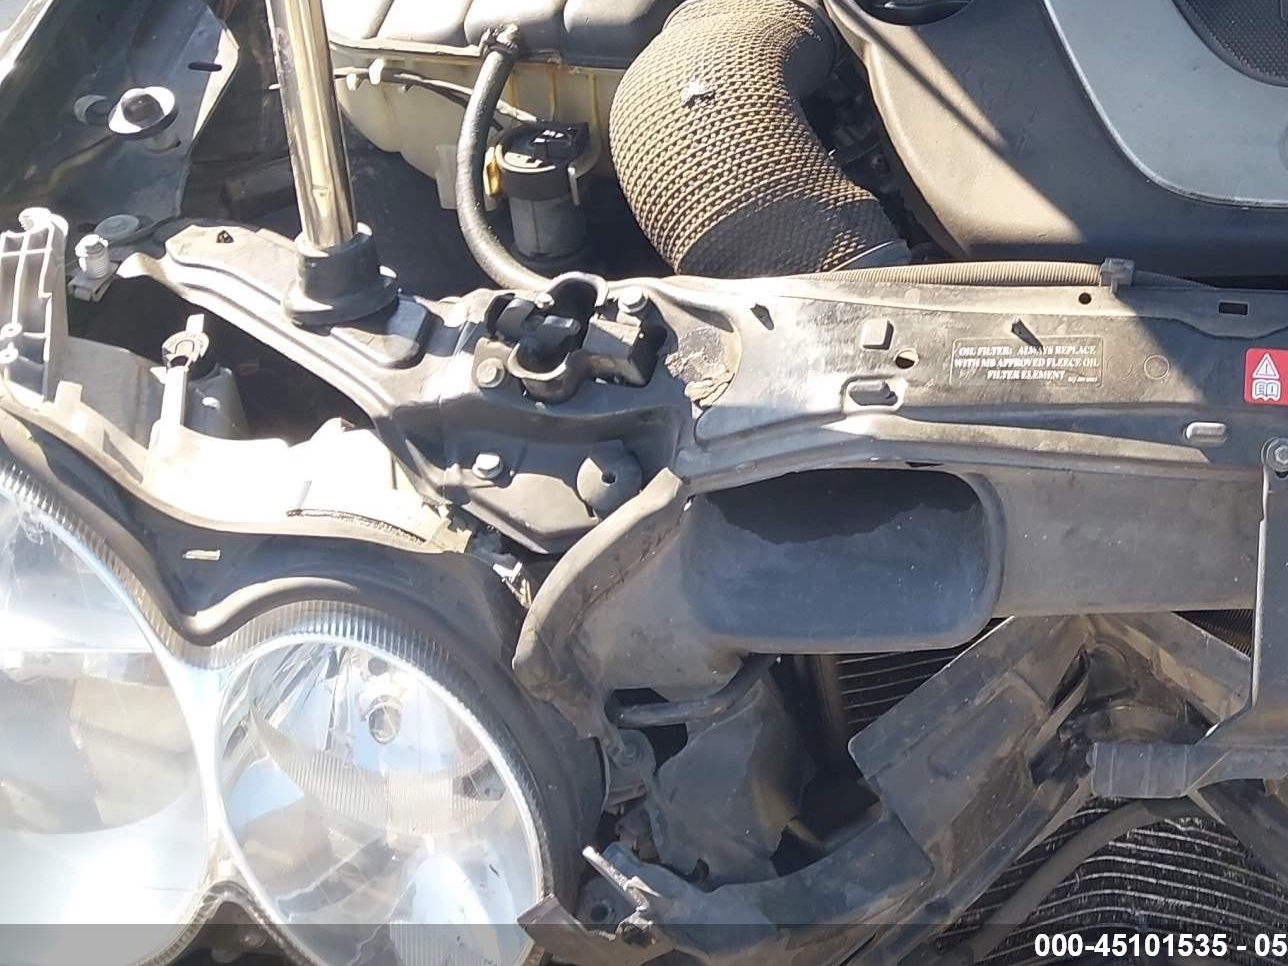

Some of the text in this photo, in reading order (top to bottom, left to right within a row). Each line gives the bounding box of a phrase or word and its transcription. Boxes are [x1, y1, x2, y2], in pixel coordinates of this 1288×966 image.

[958, 345, 1097, 356] OIL FILTER: ALWAYS REPLACE
[954, 358, 980, 368] WITH
[981, 358, 996, 368] MB
[997, 357, 1045, 368] APPROVED
[1082, 357, 1099, 368] OIL
[987, 369, 1020, 380] FILTER
[1020, 369, 1066, 380] ELEMENT
